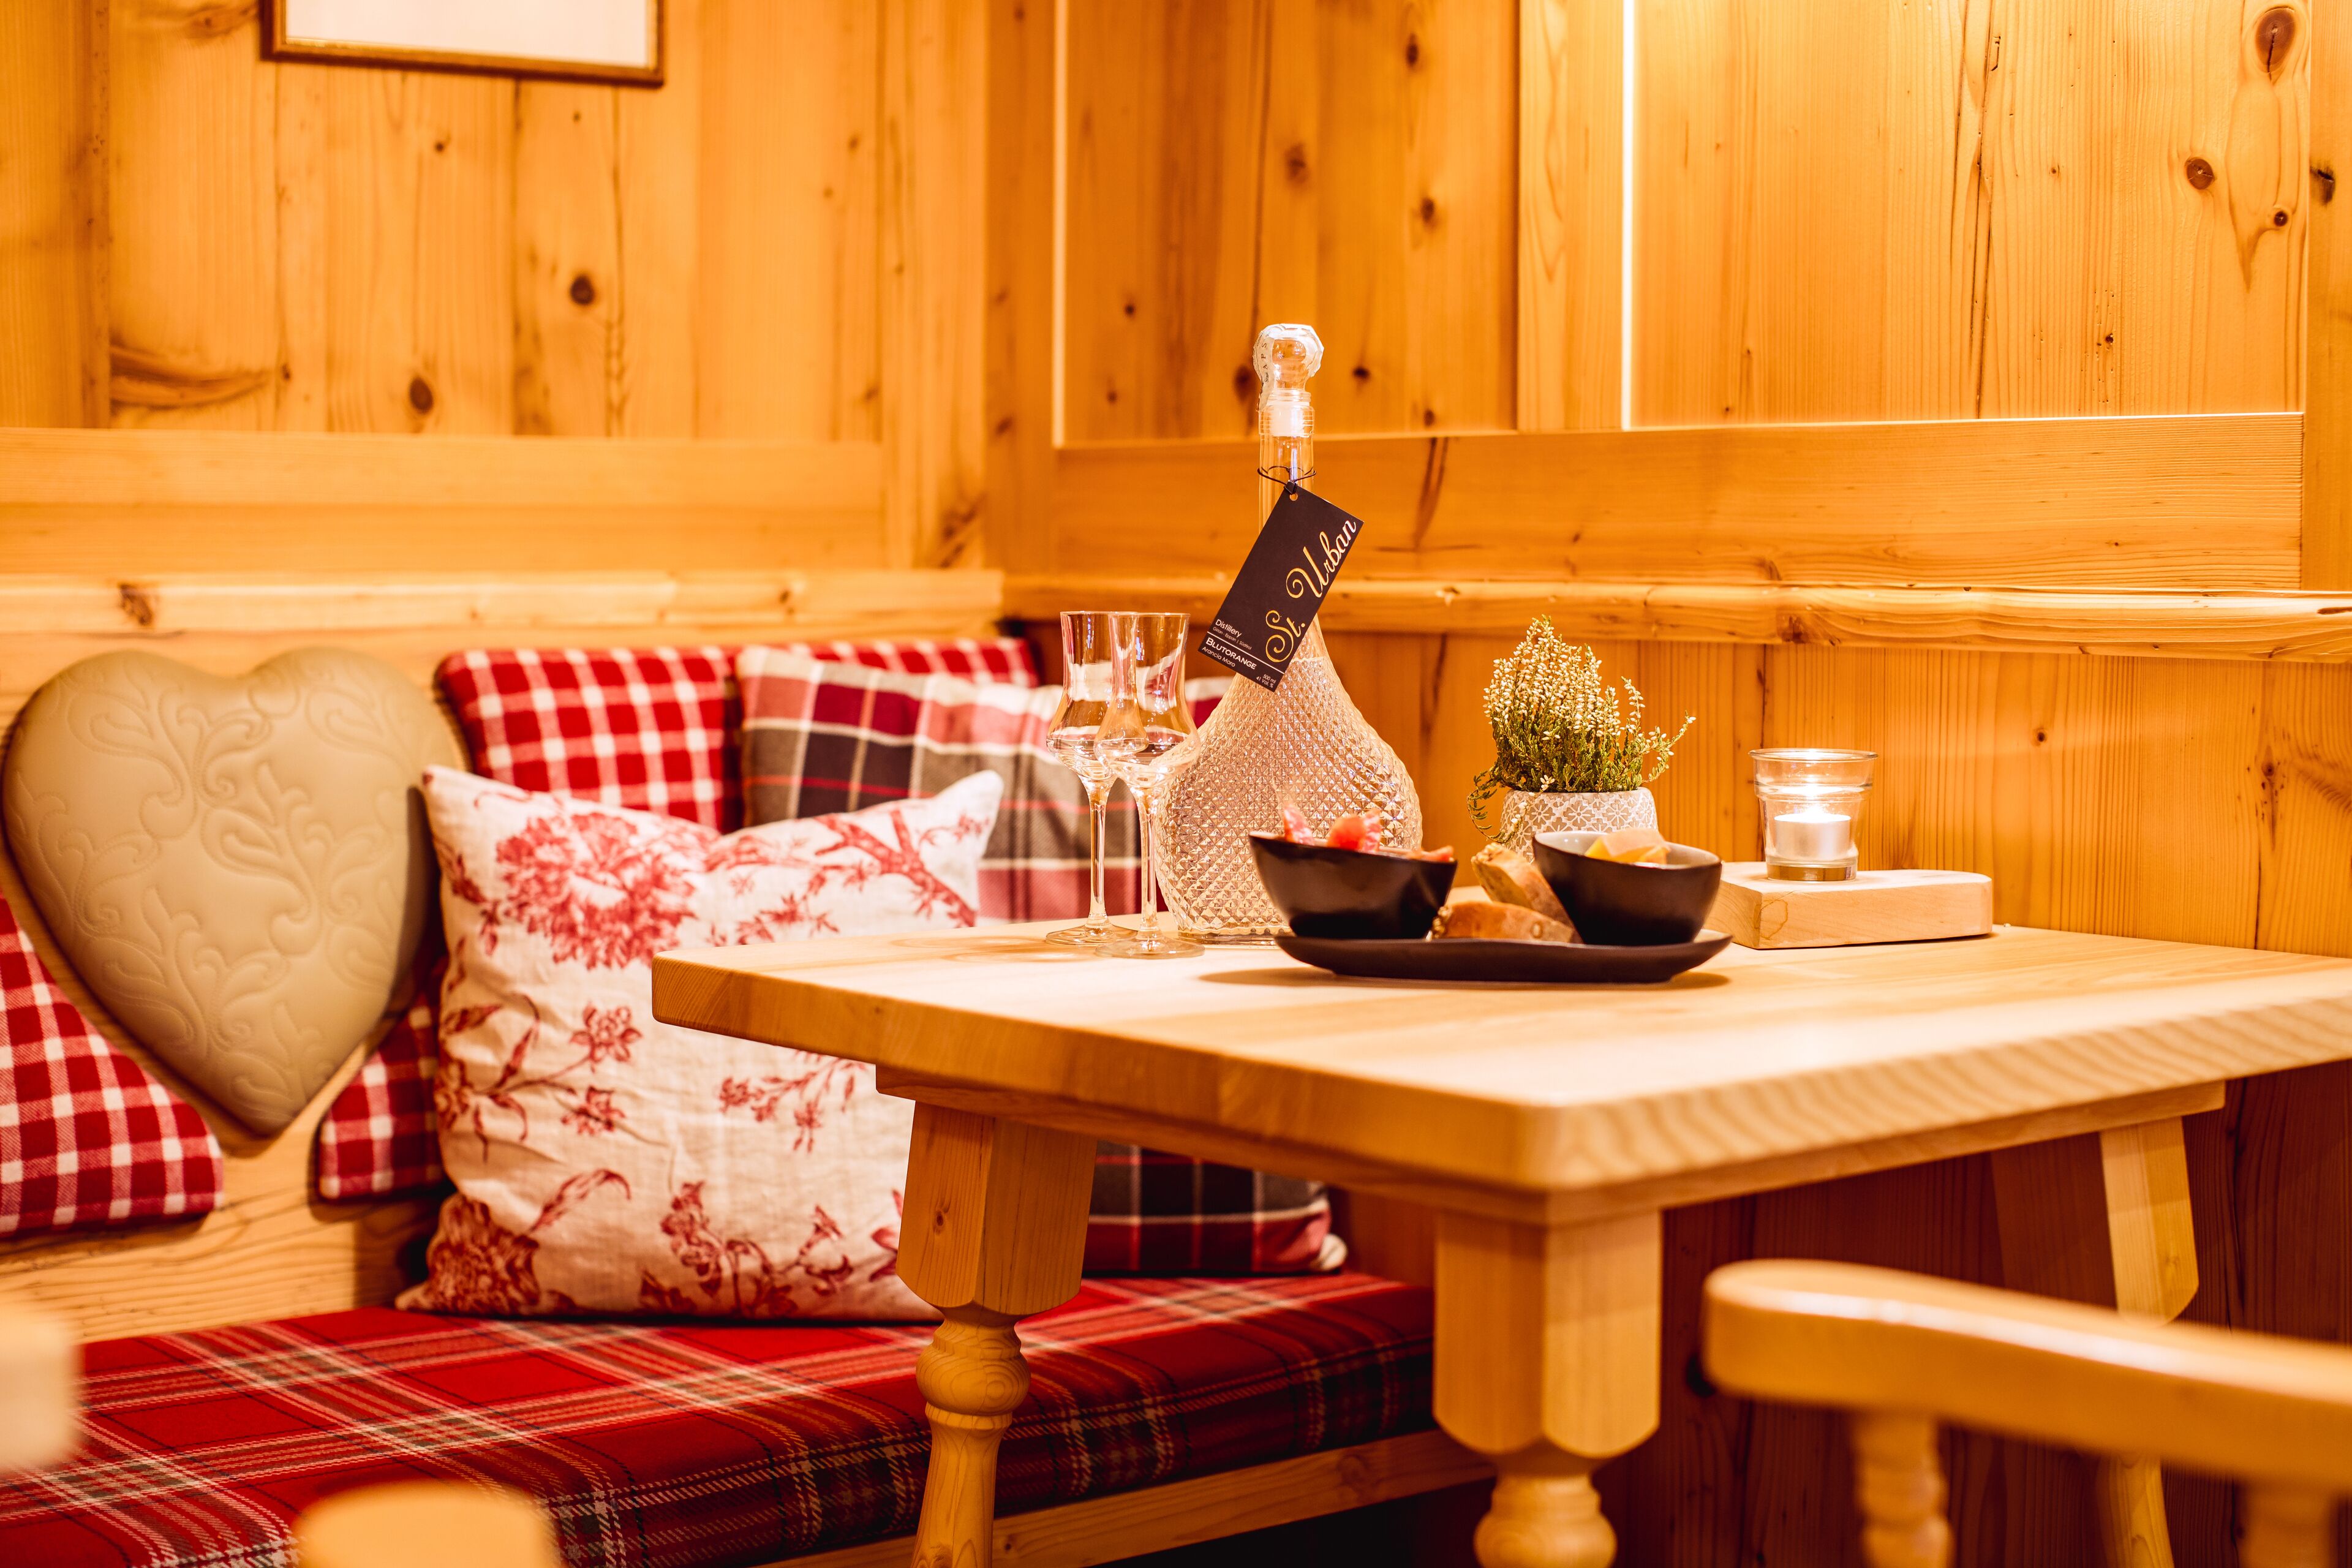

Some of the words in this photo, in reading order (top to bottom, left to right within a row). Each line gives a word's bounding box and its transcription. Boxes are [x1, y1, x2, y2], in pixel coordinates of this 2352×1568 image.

[1265, 610, 1306, 663] St.
[1286, 520, 1357, 598] Urban
[1215, 619, 1242, 638] Distillery
[1224, 633, 1237, 642] Eppan
[1202, 646, 1222, 660] Arancia
[1222, 657, 1235, 667] Moro
[1205, 637, 1257, 669] BLUTORANGE
